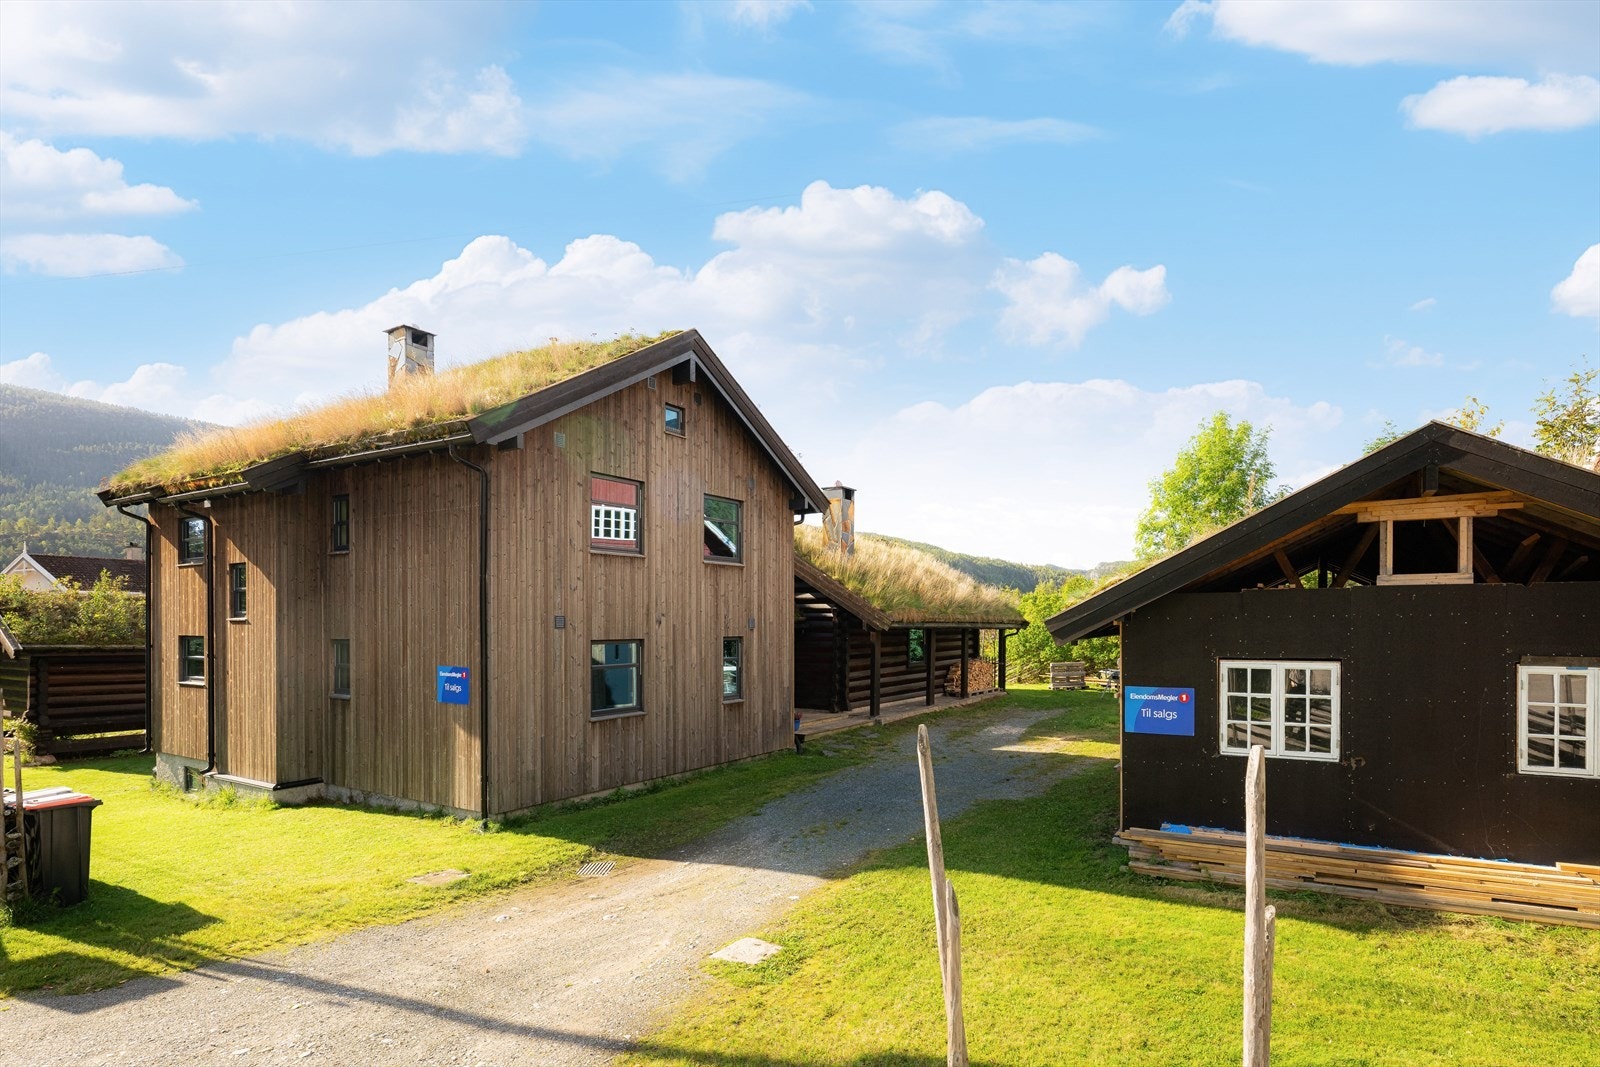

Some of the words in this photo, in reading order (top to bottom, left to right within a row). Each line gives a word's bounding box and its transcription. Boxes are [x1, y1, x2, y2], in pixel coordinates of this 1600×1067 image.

[1130, 692, 1178, 702] EiendomsMegler
[1141, 708, 1151, 718] Til
[1153, 709, 1178, 721] salgs
